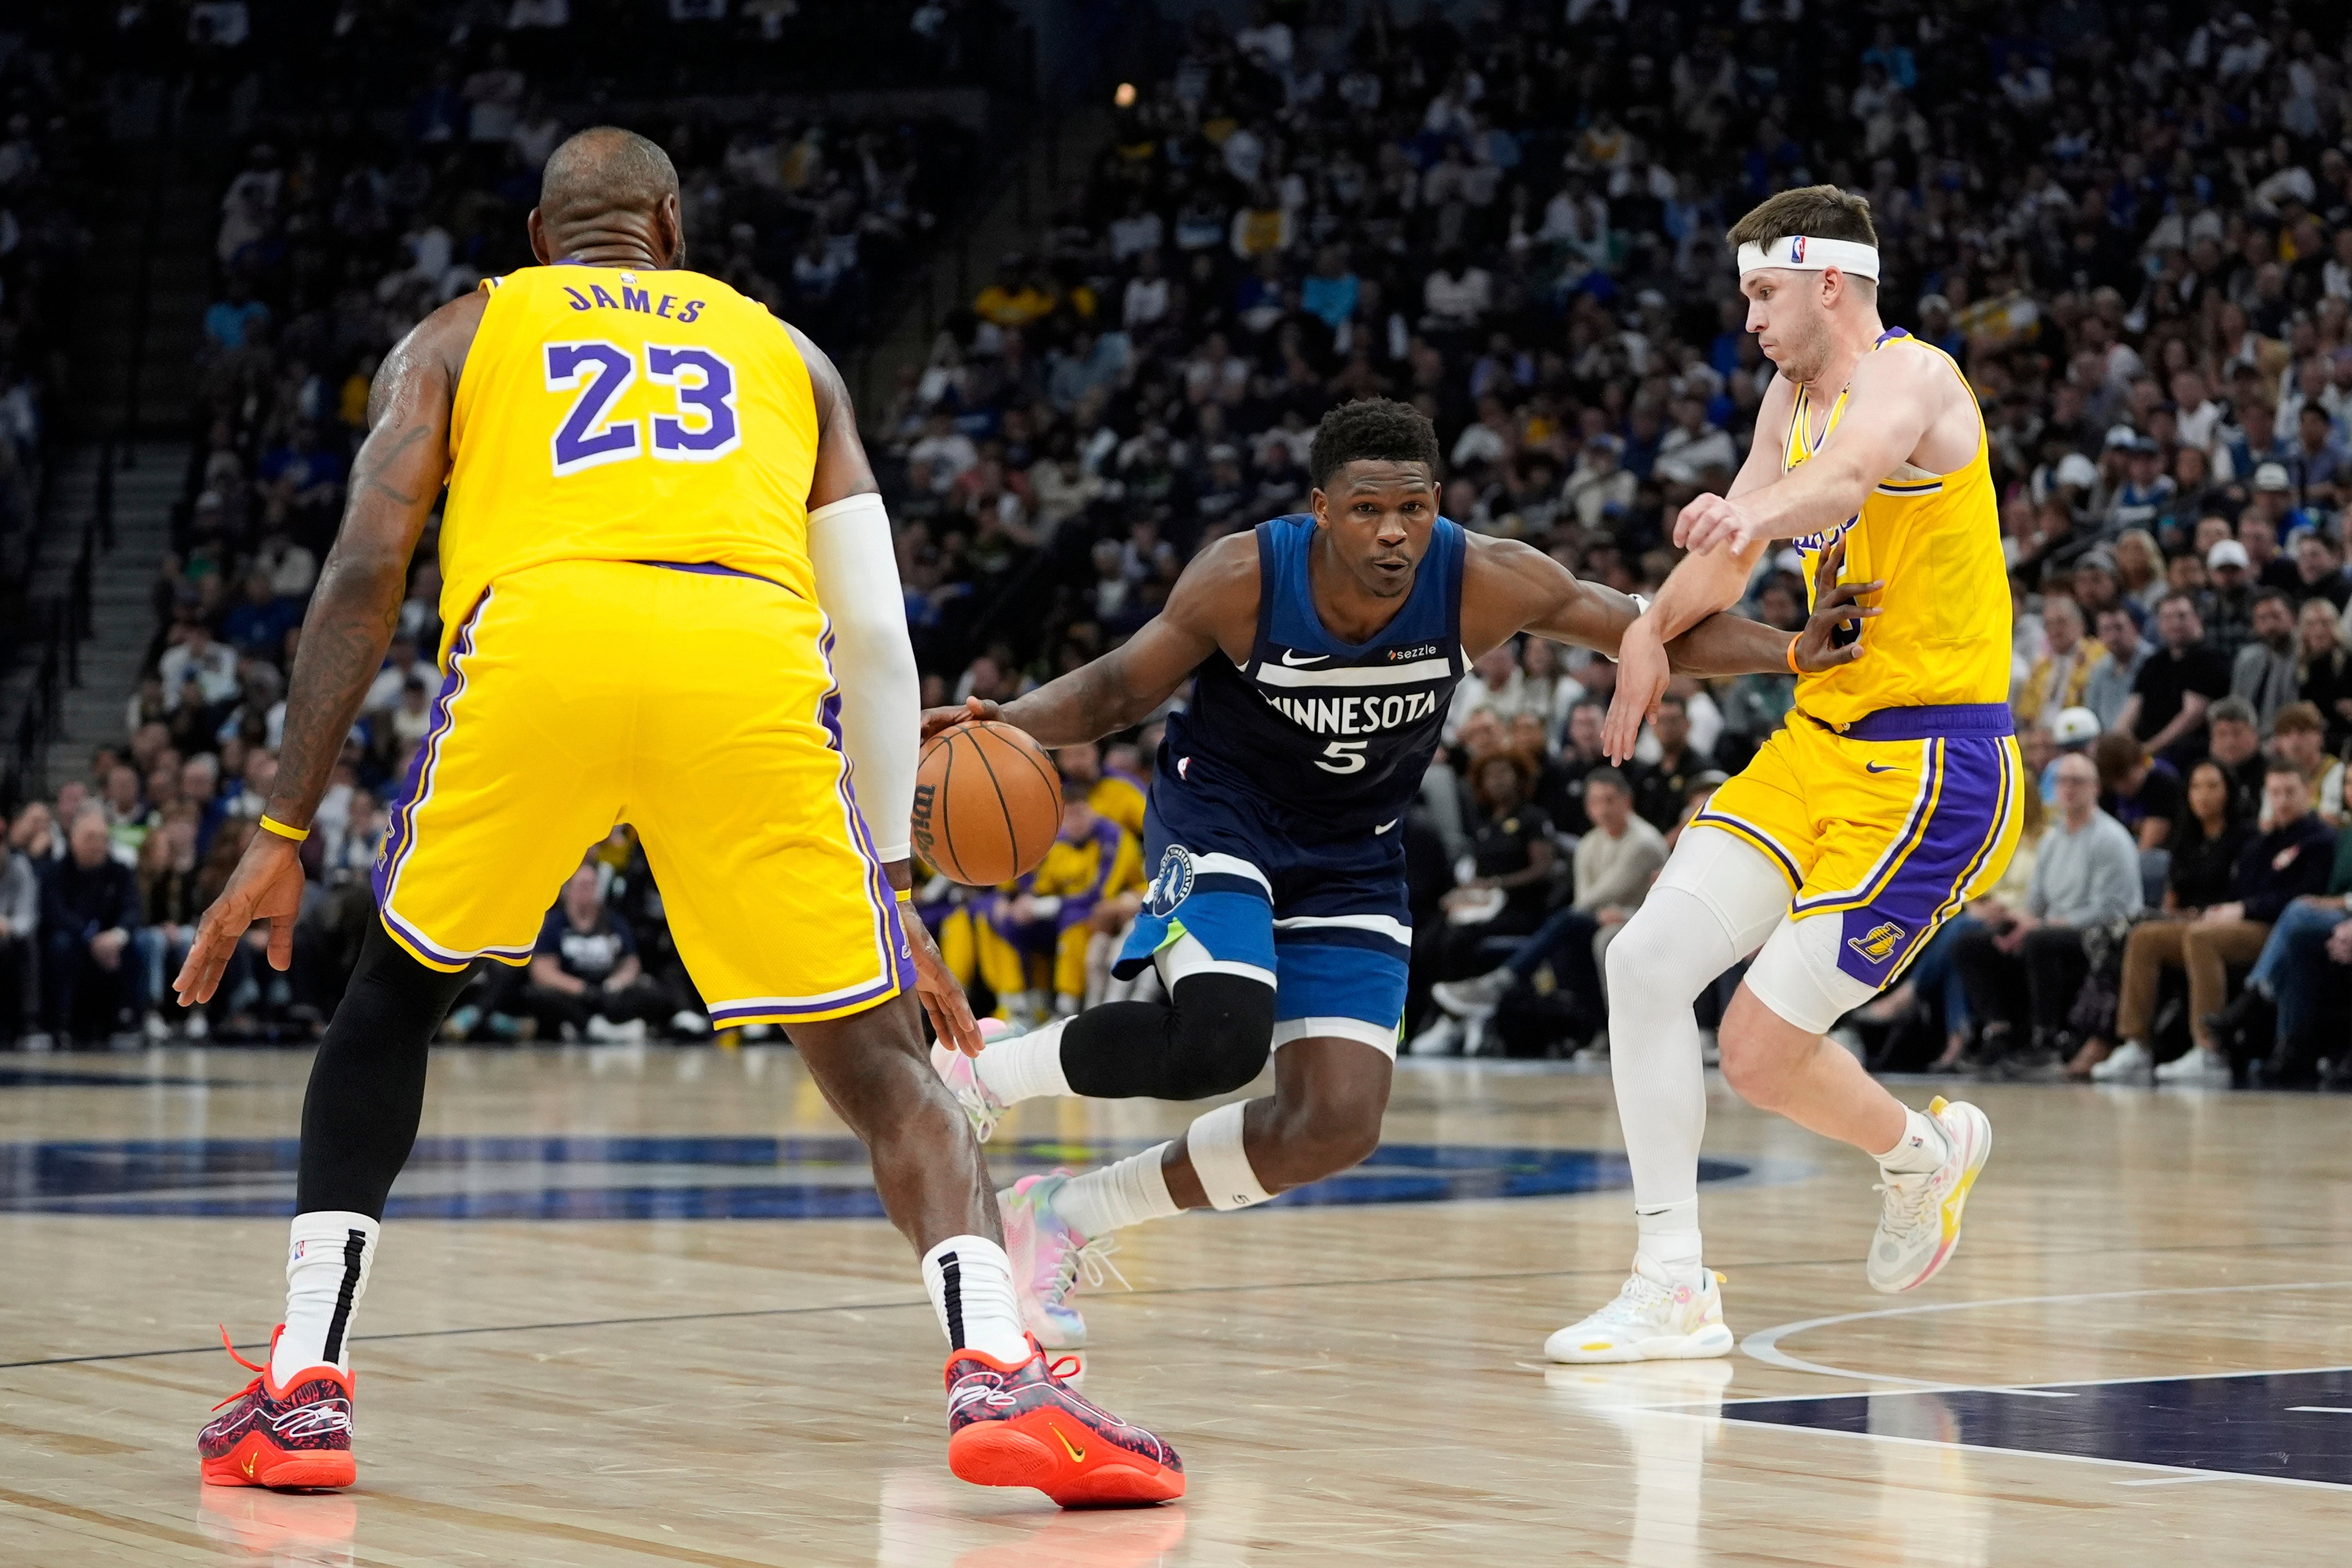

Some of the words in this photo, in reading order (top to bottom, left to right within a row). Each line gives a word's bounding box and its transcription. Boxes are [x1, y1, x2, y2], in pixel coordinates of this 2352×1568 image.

[562, 285, 706, 323] JAMES
[542, 339, 742, 477] 23
[1397, 644, 1437, 659] sezzle
[1314, 741, 1368, 774] 5
